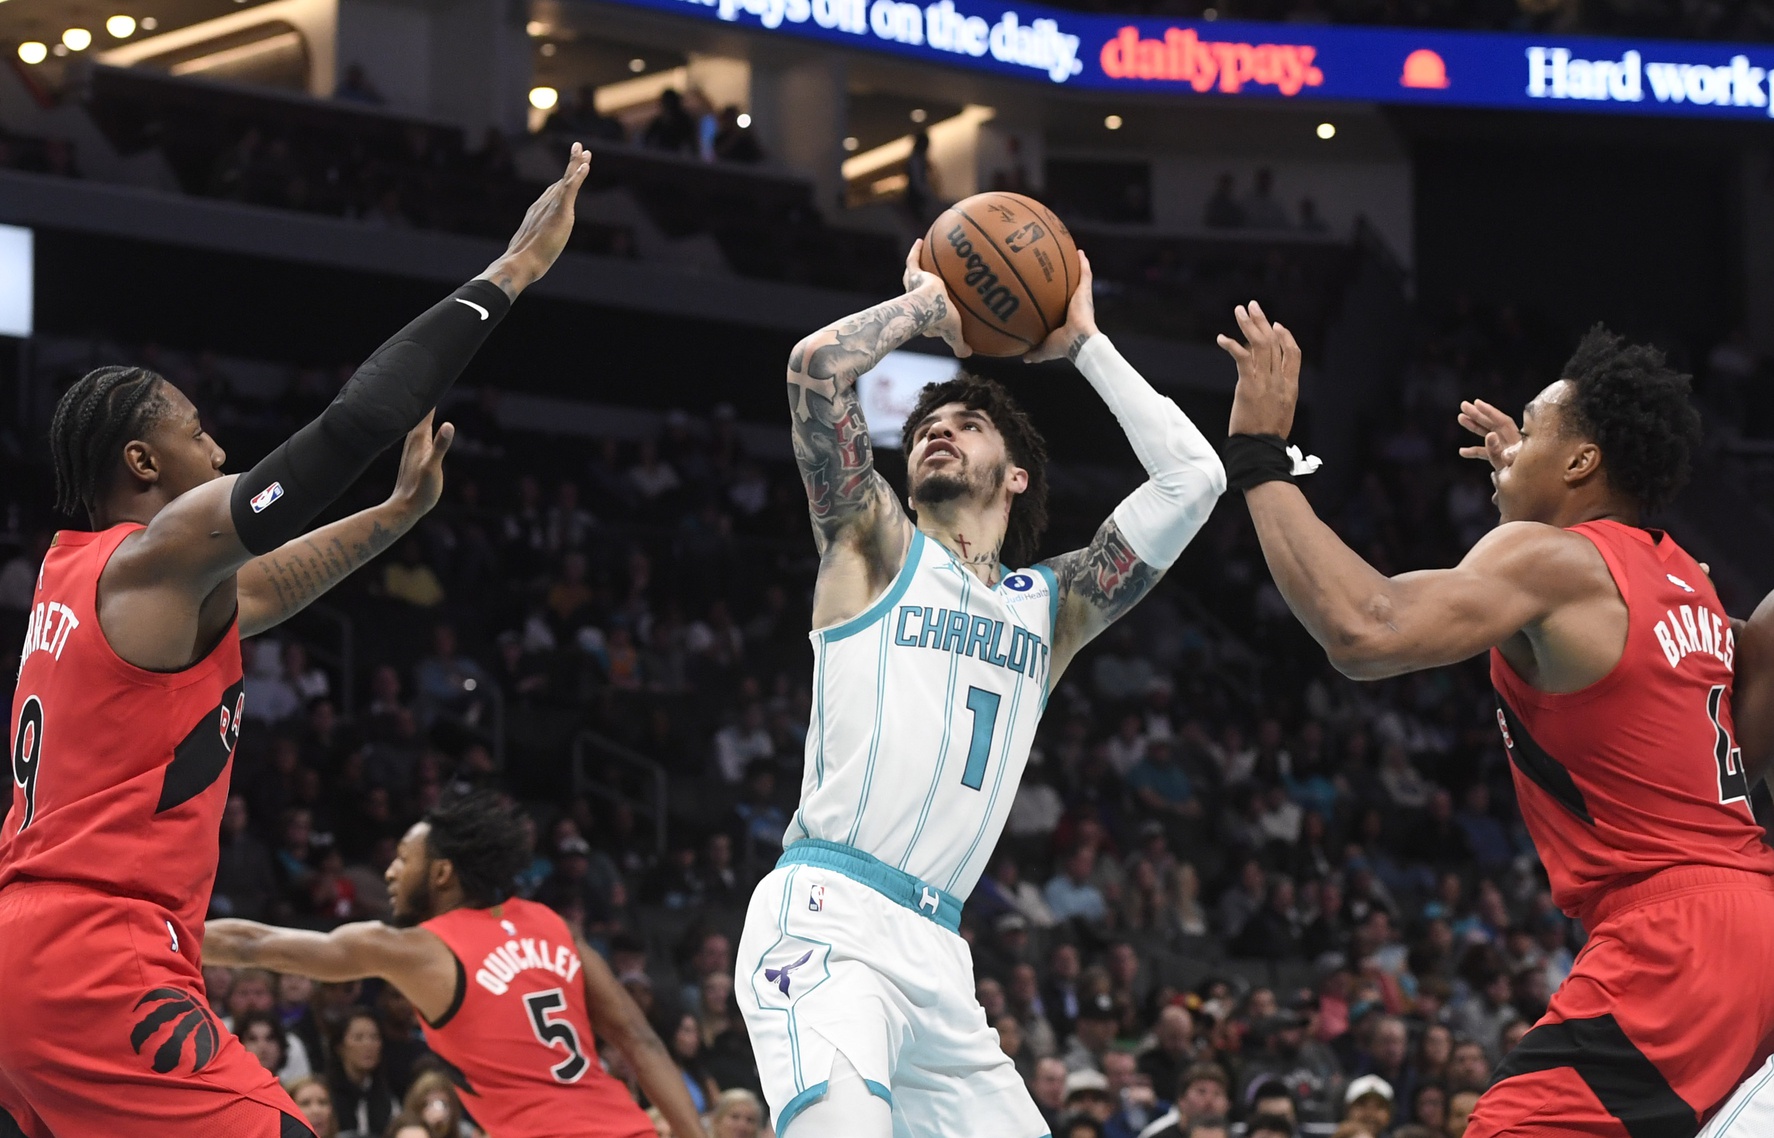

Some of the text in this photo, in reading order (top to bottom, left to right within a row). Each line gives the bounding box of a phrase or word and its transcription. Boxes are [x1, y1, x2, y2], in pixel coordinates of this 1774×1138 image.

[870, 0, 925, 45] on
[925, 0, 990, 57] the
[1100, 25, 1323, 96] dailypay.
[1525, 46, 1645, 102] Hard
[1645, 54, 1768, 108] work
[947, 224, 1020, 323] Wilson
[1654, 605, 1735, 672] BARNES
[13, 695, 44, 835] 9
[960, 685, 1002, 791] 1
[475, 938, 582, 996] QUICKLEY
[522, 986, 591, 1085] 5
